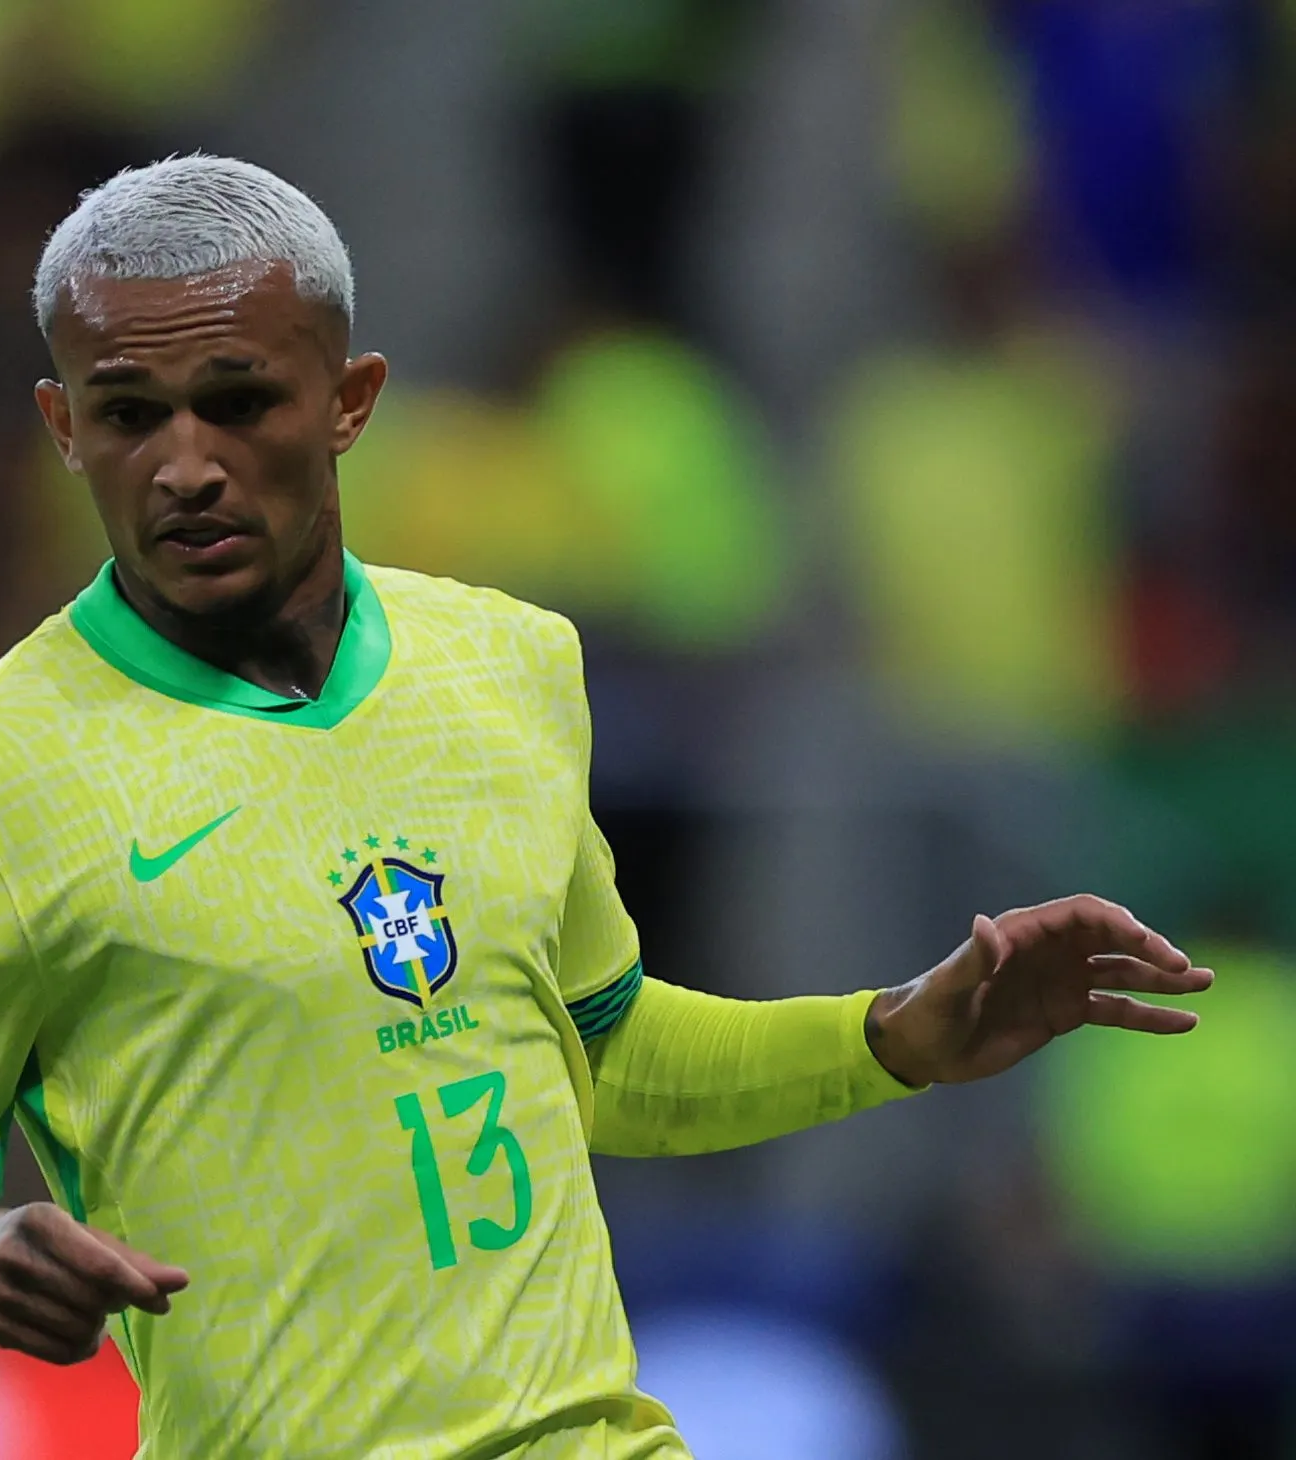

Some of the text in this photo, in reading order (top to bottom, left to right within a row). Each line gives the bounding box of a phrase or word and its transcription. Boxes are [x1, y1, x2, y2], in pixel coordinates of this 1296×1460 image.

[383, 915, 419, 939] CBF
[376, 1005, 479, 1053] BRASIL
[394, 1071, 532, 1271] 13
